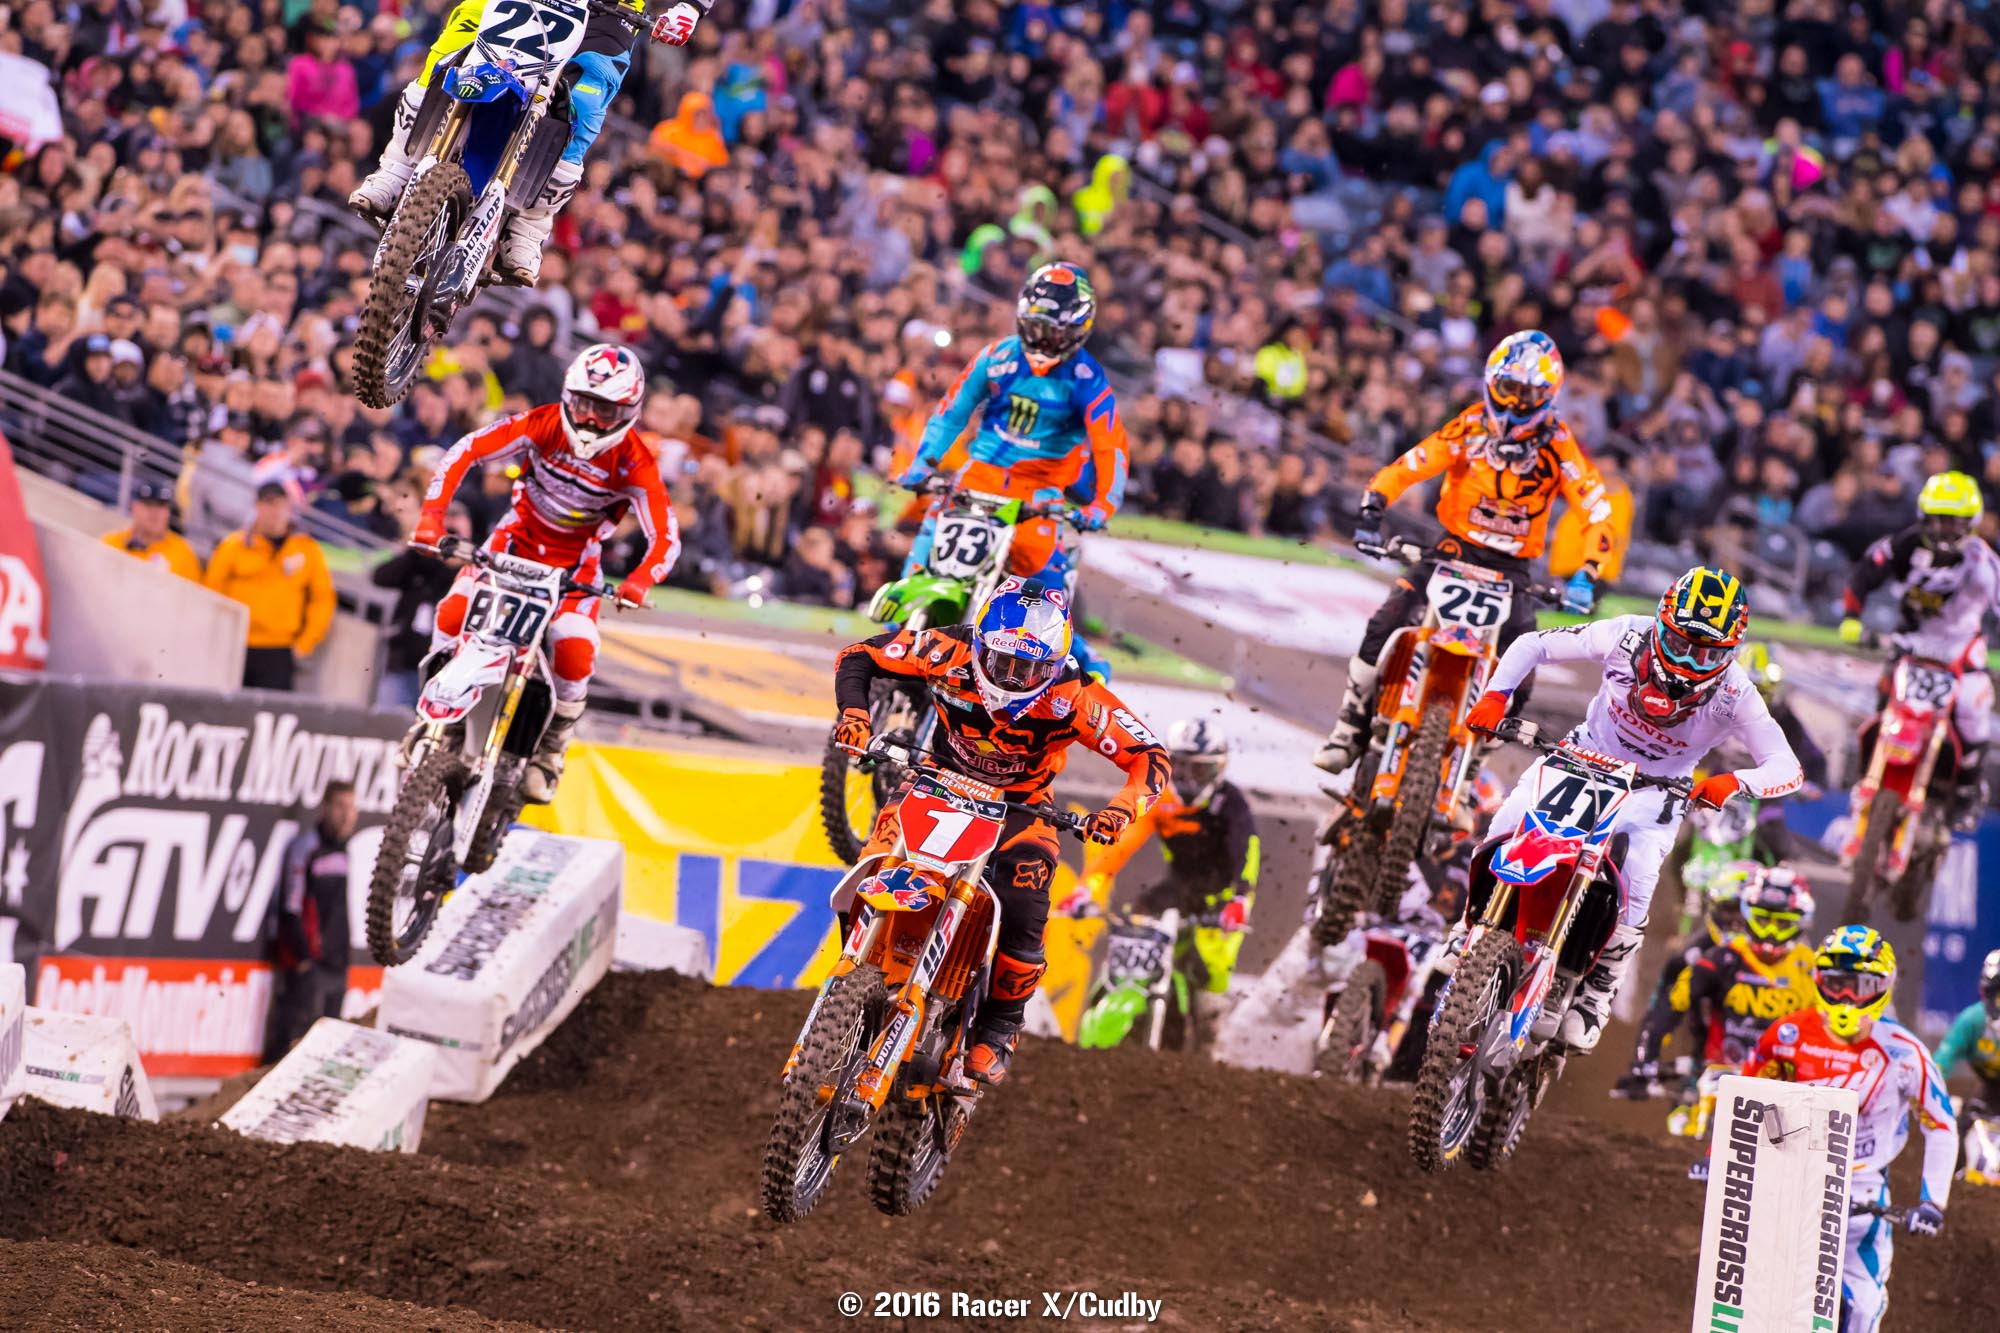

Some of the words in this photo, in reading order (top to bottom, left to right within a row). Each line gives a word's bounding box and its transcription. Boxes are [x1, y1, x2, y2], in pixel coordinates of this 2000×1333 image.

[478, 0, 575, 62] 22
[936, 522, 994, 566] 33
[1438, 585, 1503, 627] 25
[991, 637, 1017, 648] Red
[1018, 640, 1044, 658] Bull
[123, 703, 249, 800] ROCKY
[982, 758, 1026, 775] Bull
[1563, 742, 1628, 767] RENTHA
[940, 777, 994, 801] RENTHAL
[943, 768, 997, 793] RENTHAL
[1763, 767, 1804, 797] HOND
[1536, 776, 1616, 833] 41
[918, 809, 975, 859] 1
[1495, 868, 1526, 882] HONDA
[873, 1013, 908, 1069] DUNLOP
